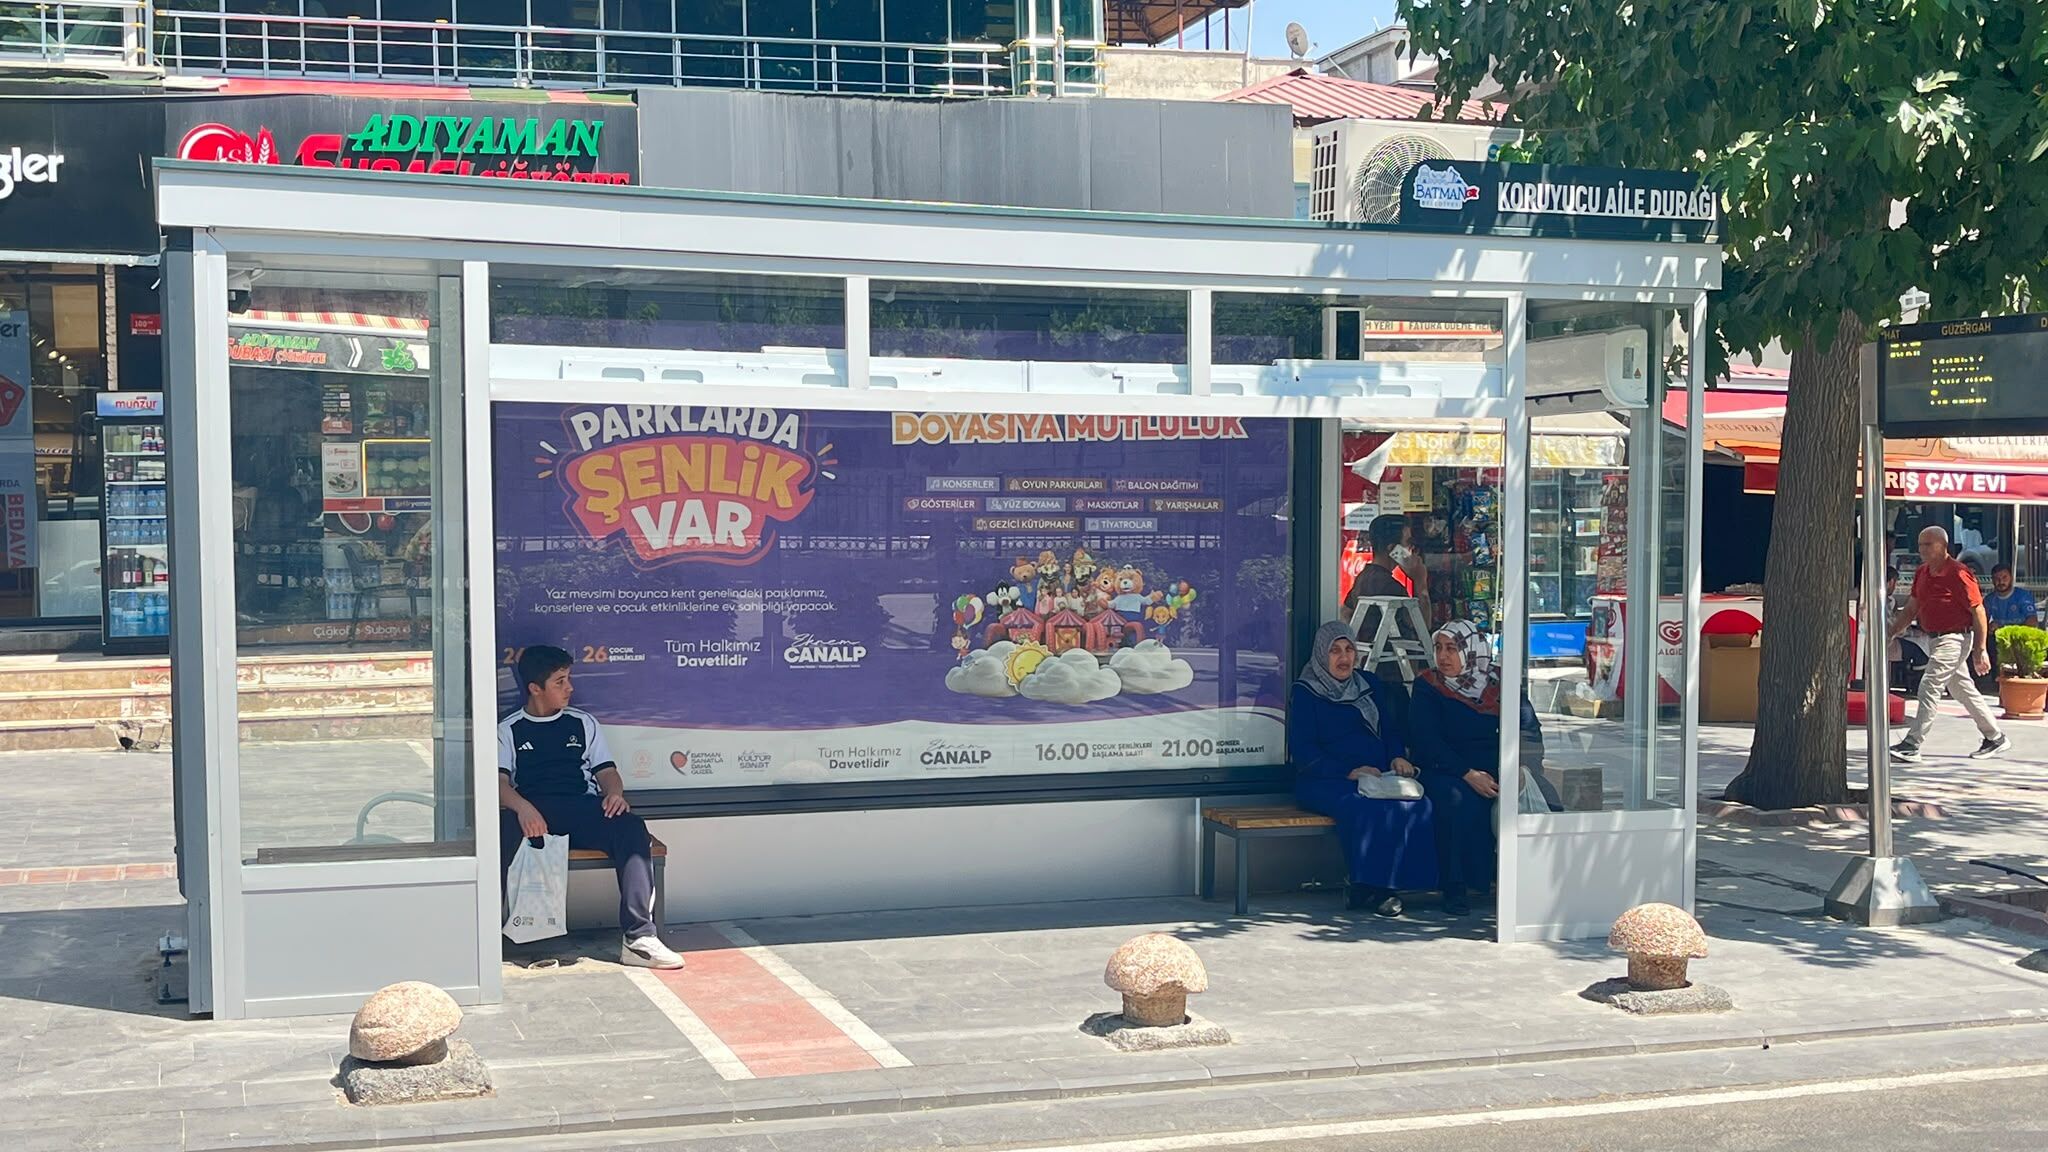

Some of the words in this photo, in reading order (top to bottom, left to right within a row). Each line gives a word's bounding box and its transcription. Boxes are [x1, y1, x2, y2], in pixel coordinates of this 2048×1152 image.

[348, 113, 604, 157] ADIYAMAN
[1415, 184, 1467, 200] BATMAN
[1498, 181, 1600, 215] KORUYUCU
[1603, 180, 1645, 216] AİLE
[1651, 185, 1717, 219] DURAĞI
[570, 404, 799, 451] PARKLARDA
[893, 412, 1063, 444] DOYASIYA
[1065, 414, 1248, 441] MUTLULUK
[578, 443, 803, 524] ŞENLİK
[942, 480, 994, 489] KONSERLER
[1022, 480, 1048, 489] OYUN
[1050, 480, 1103, 490] PARKURLARI
[1127, 480, 1159, 490] BALON
[1160, 479, 1199, 490] DAĞITIMI
[1884, 471, 1919, 493] RIŞ
[1925, 472, 1966, 494] ÇAY
[1973, 474, 2006, 492] EVİ
[920, 498, 975, 509] GÖSTERİLER
[1003, 499, 1021, 509] YÜZ
[1023, 500, 1061, 509] BOYAMA
[1087, 501, 1139, 510] MASKOTLAR
[1165, 501, 1219, 511] YARIŞMALAR
[8, 494, 26, 567] BEDAVA
[631, 499, 752, 550] VAR
[989, 519, 1020, 529] GEZİCİ
[1021, 519, 1075, 529] KÜTÜPHANE
[1102, 519, 1153, 529] TİYATROLAR
[545, 588, 567, 599] Yaz
[569, 588, 615, 599] mevsimi
[618, 589, 669, 600] boyunca
[671, 588, 696, 599] kent
[698, 588, 763, 600] genelindeki
[534, 602, 594, 613] konserlere
[597, 604, 610, 613] ve
[613, 602, 648, 614] çocuk
[650, 602, 720, 613] etkinliklerine
[722, 604, 736, 612] ev
[738, 602, 784, 613] sahipliği
[664, 639, 696, 653] Tüm
[699, 638, 761, 653] Halkımız
[583, 645, 609, 663] 26
[677, 653, 748, 668] Davetlidir
[783, 646, 867, 663] CANALP
[817, 747, 845, 759] Tüm
[848, 746, 902, 758] Halkımız
[1035, 742, 1089, 761] 16.00
[1161, 739, 1214, 758] 21.00
[829, 758, 890, 769] Davetlidir
[920, 750, 992, 766] CANALP
